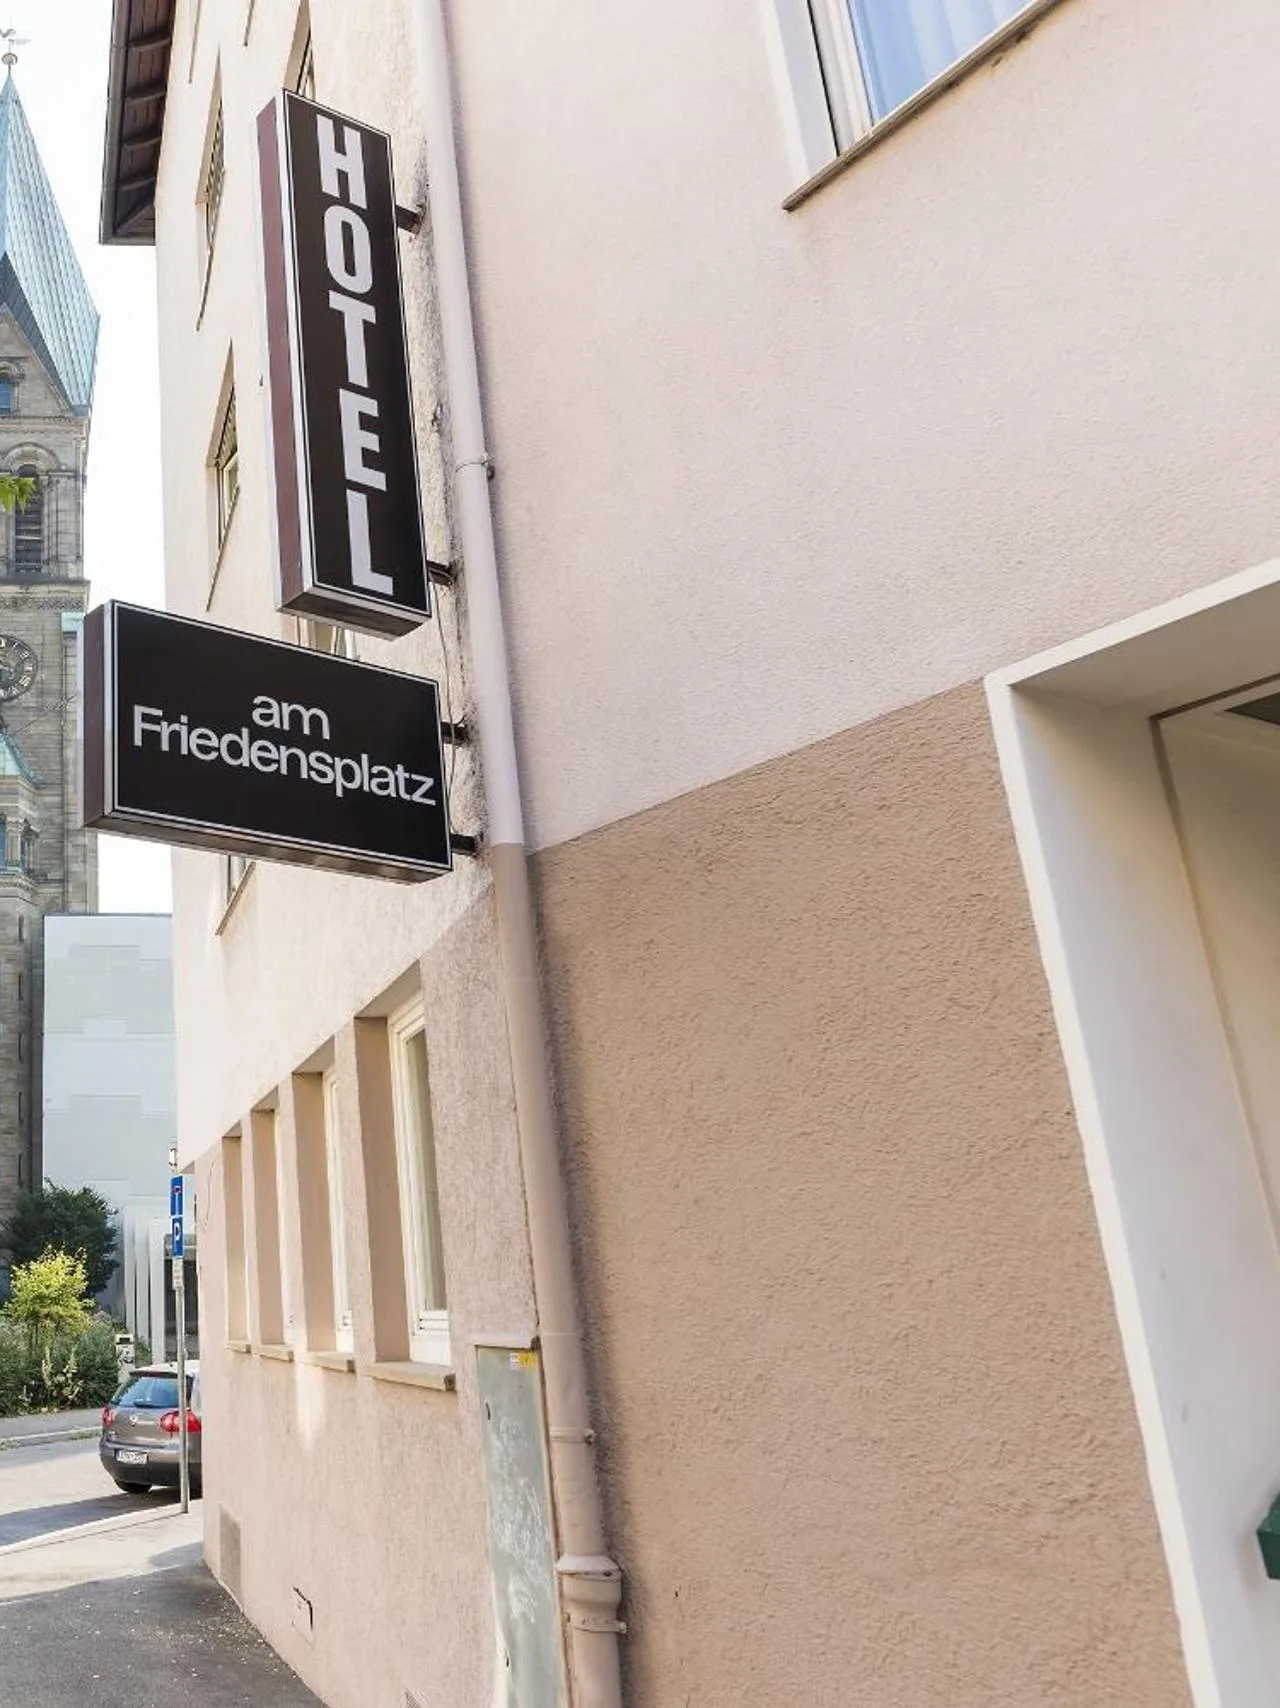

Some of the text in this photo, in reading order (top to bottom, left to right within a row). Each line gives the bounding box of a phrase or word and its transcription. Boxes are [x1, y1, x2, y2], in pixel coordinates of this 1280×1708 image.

[315, 113, 394, 596] HOTEL
[132, 703, 437, 807] Friedensplatz
[252, 694, 330, 740] am
